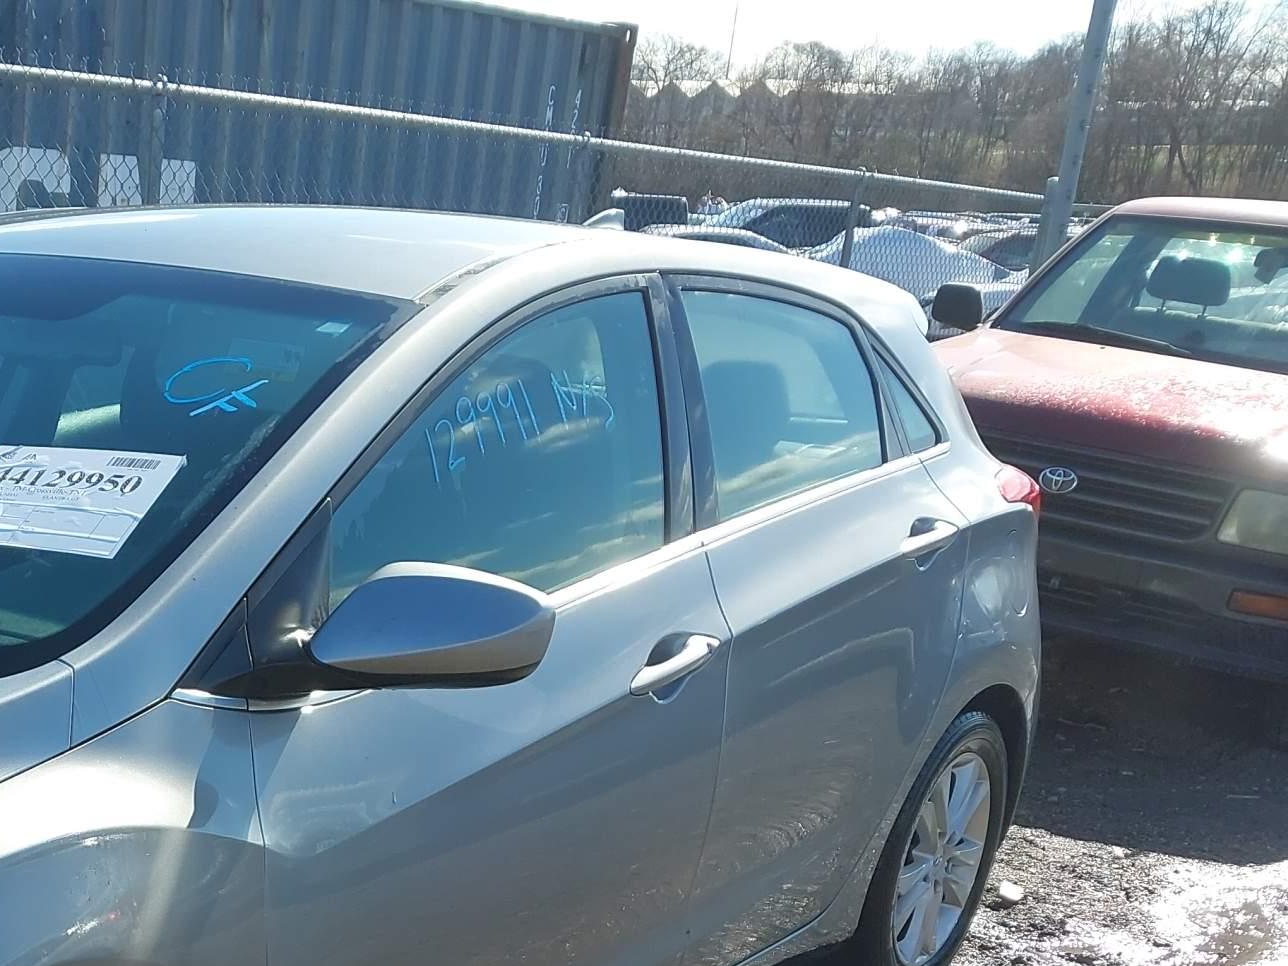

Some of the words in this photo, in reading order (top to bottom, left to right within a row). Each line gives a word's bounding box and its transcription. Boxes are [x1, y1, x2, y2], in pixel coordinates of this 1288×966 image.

[539, 85, 556, 167] CMU
[565, 89, 582, 168] 421
[424, 379, 542, 484] 129991
